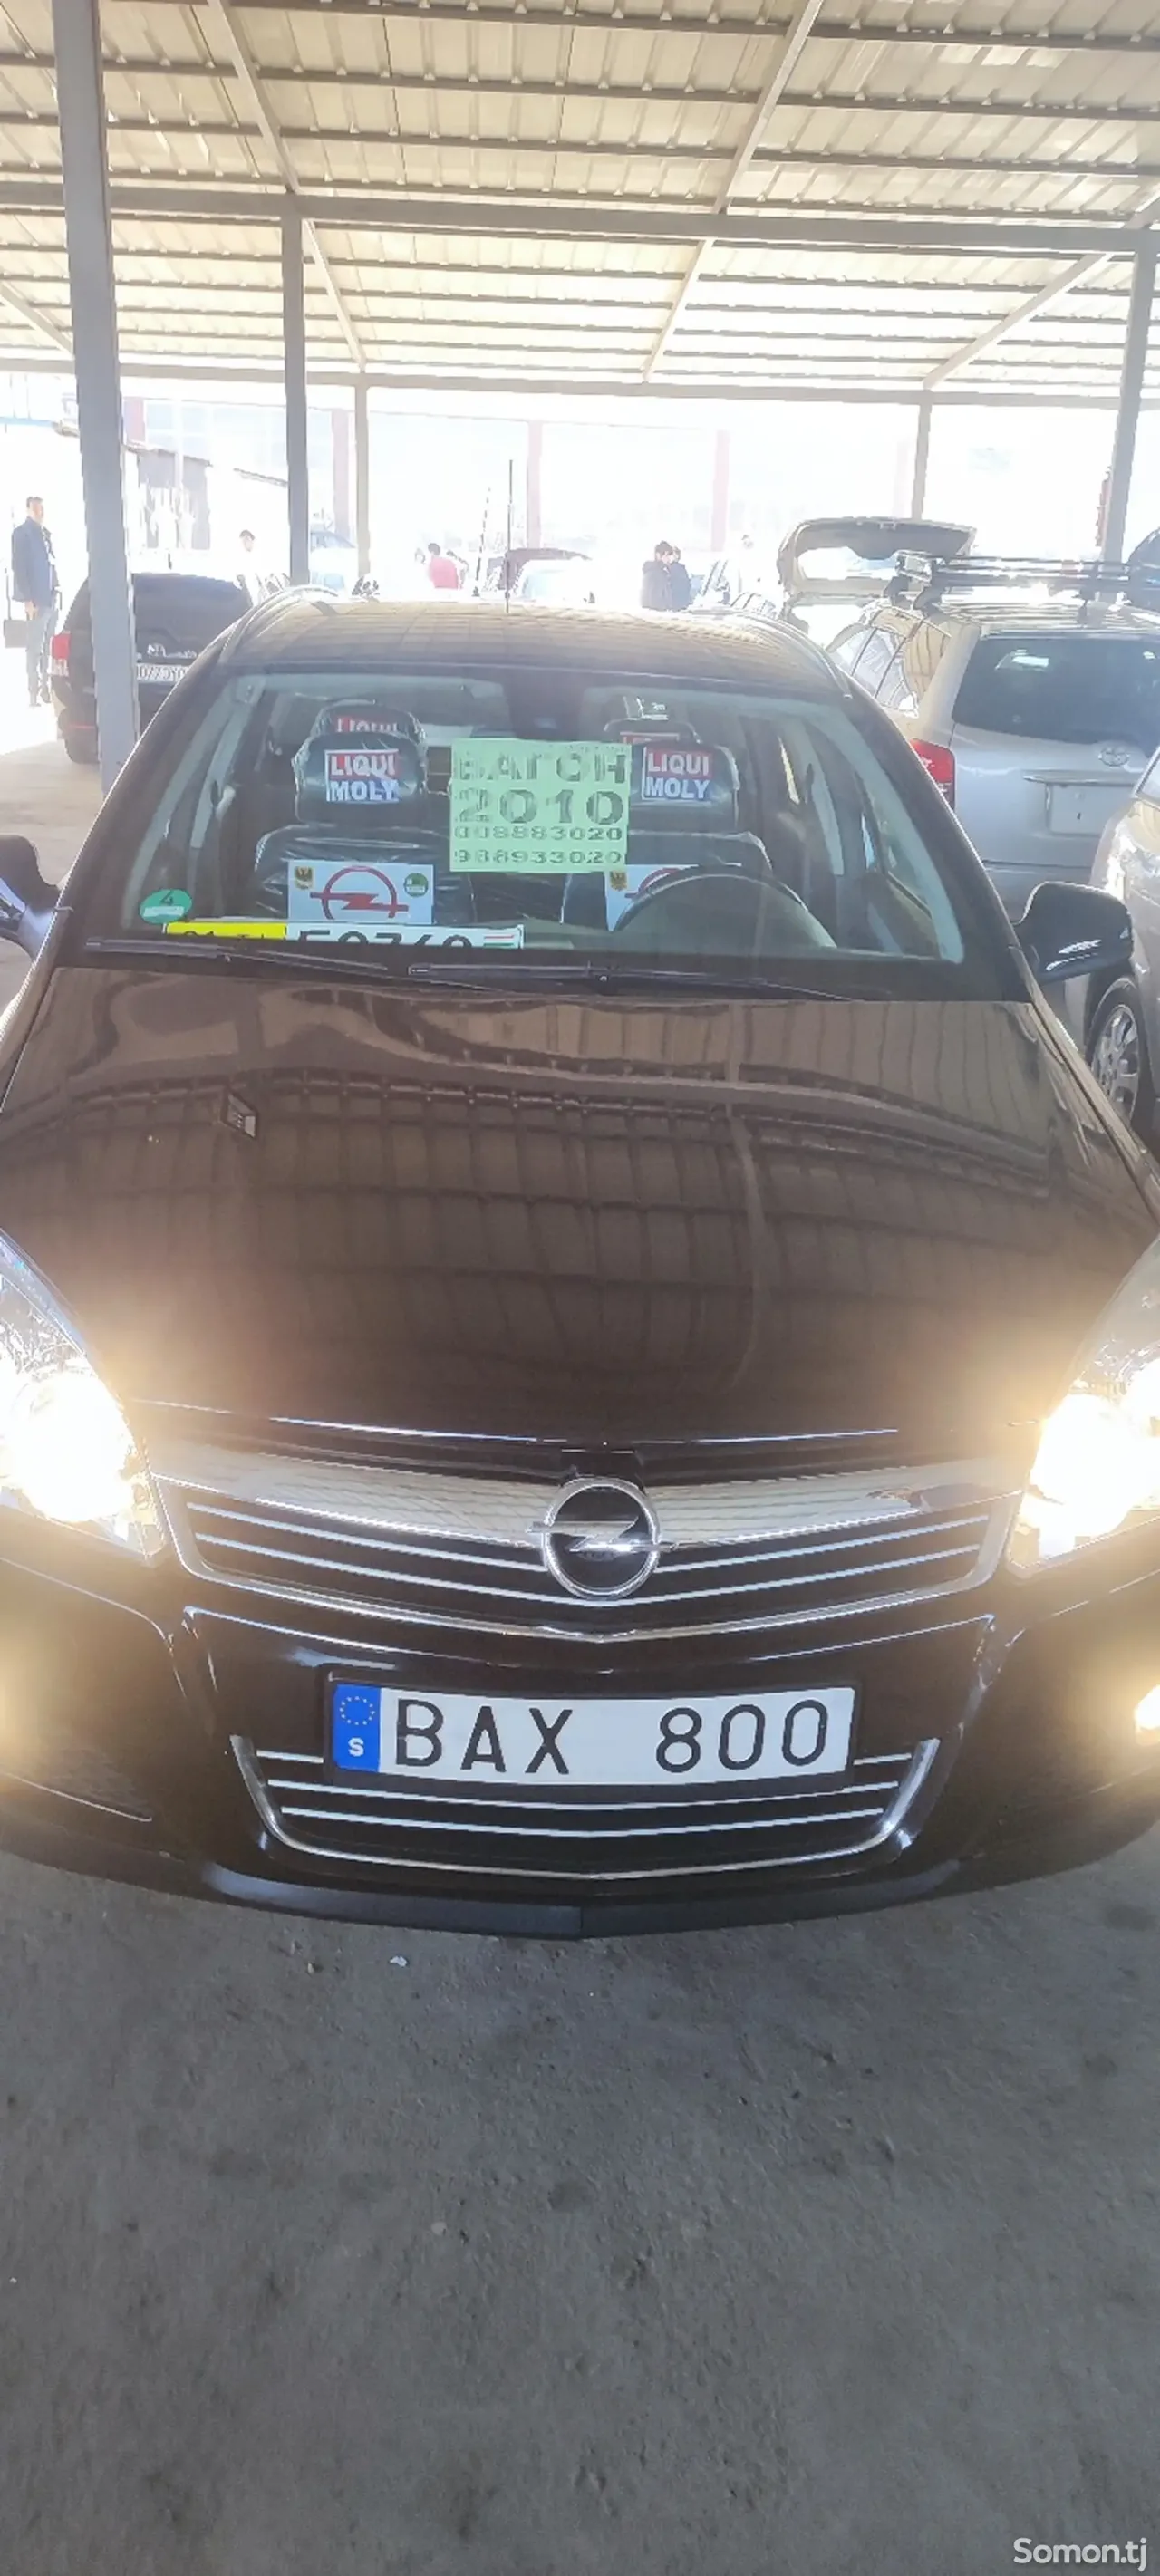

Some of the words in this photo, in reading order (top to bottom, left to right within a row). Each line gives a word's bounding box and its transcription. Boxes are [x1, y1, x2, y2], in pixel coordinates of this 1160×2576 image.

[331, 754, 396, 777] LIQUI
[648, 753, 709, 776] LIQUI
[330, 780, 400, 801] MOLY
[646, 777, 710, 798] MOLY
[455, 787, 624, 825] 2010
[348, 1737, 364, 1757] S
[395, 1699, 573, 1775] BAX
[655, 1699, 828, 1773] 800
